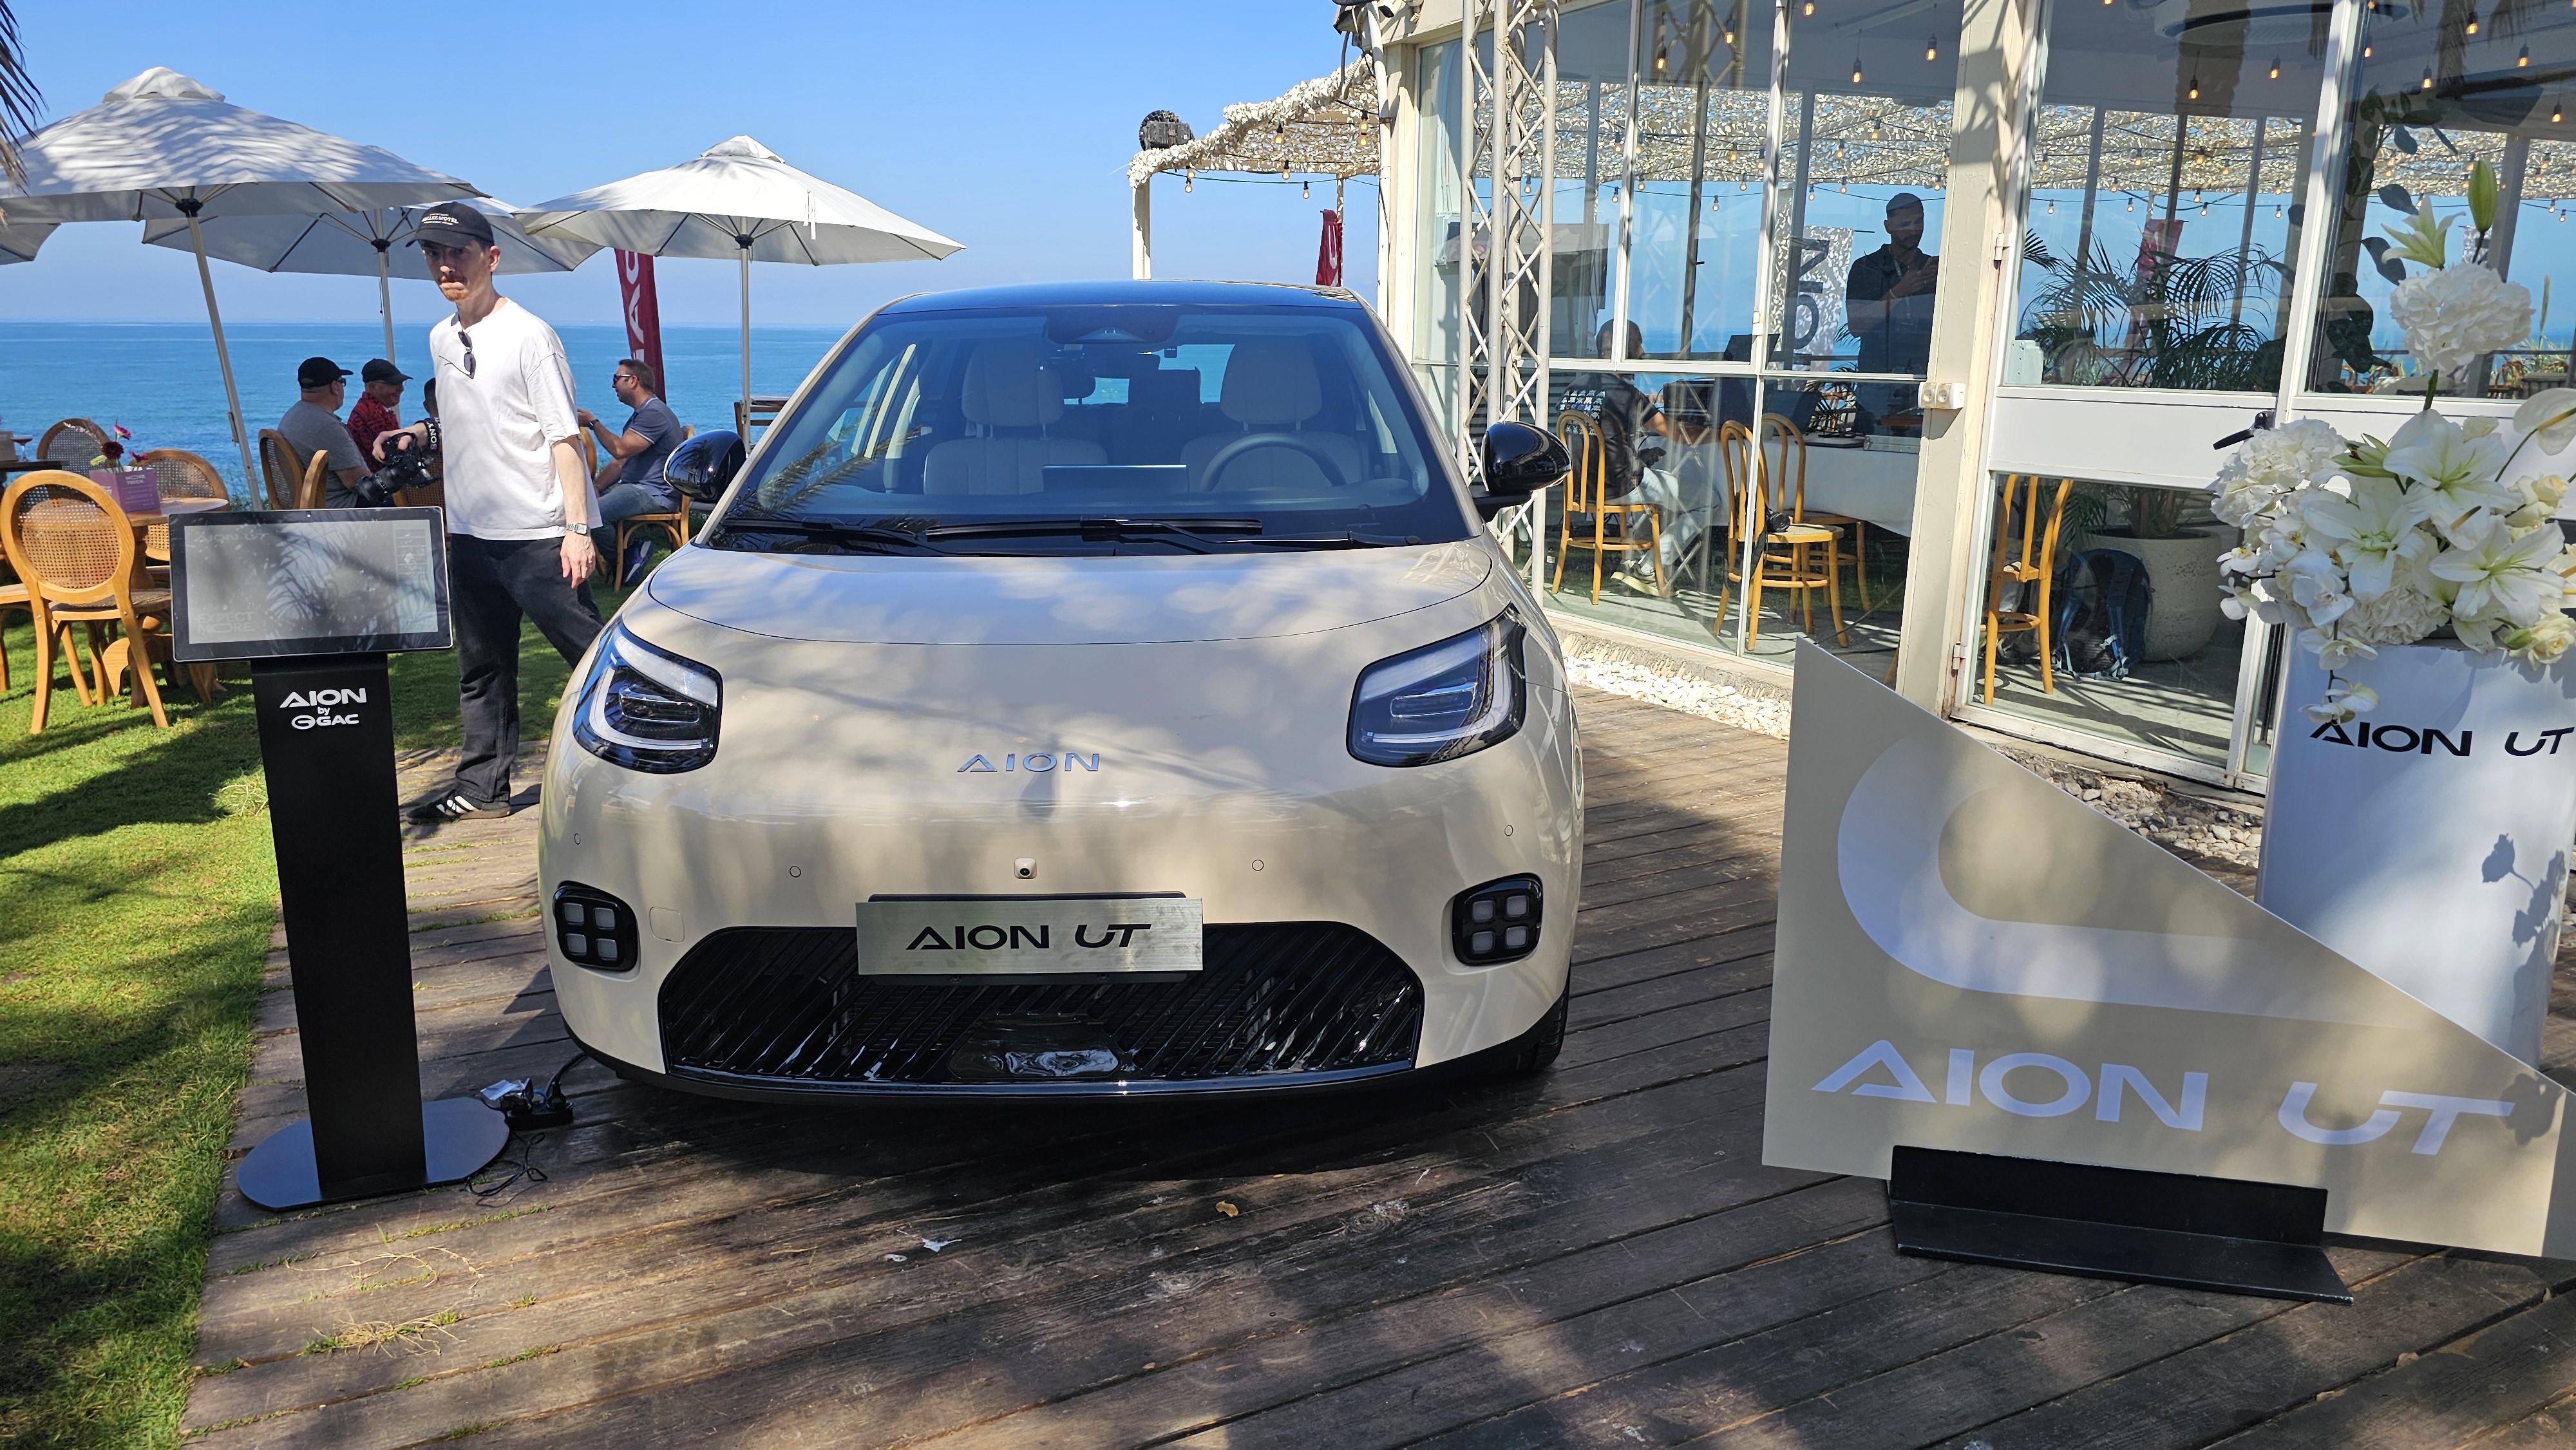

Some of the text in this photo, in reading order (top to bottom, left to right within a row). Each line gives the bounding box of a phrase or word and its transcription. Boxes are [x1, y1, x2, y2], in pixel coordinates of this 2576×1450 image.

[625, 250, 645, 362] AC
[1792, 237, 1830, 370] ION
[426, 421, 437, 450] SONY
[196, 612, 254, 623] EXPECT
[197, 622, 255, 634] MORE
[279, 688, 366, 708] AION
[317, 706, 330, 715] by
[2309, 719, 2575, 757] AION UT
[957, 753, 1100, 772] AION
[905, 923, 1152, 950] AION UT
[1811, 1039, 2516, 1156] AION UT
